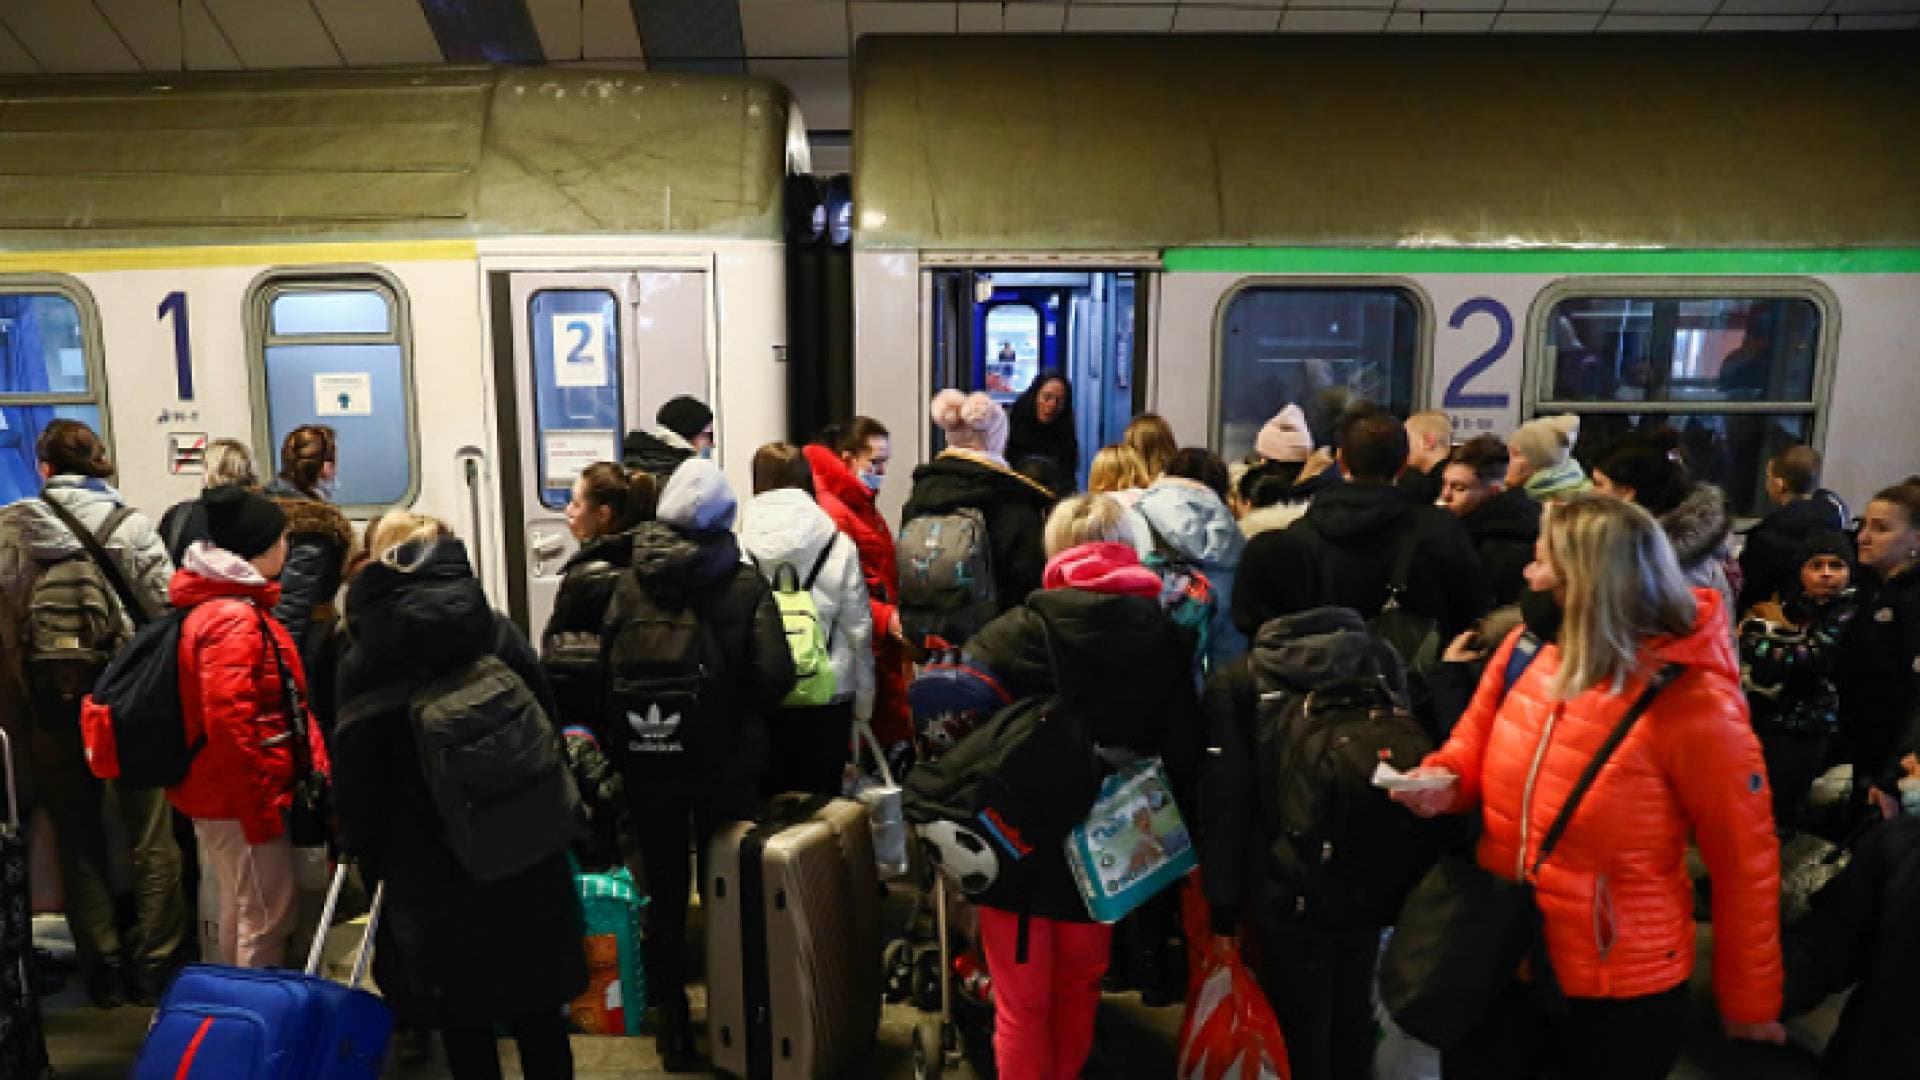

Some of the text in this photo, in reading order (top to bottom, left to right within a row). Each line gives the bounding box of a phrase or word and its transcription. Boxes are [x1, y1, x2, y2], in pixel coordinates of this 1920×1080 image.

[157, 291, 194, 401] 1
[566, 321, 595, 364] 2
[1444, 296, 1514, 408] 2
